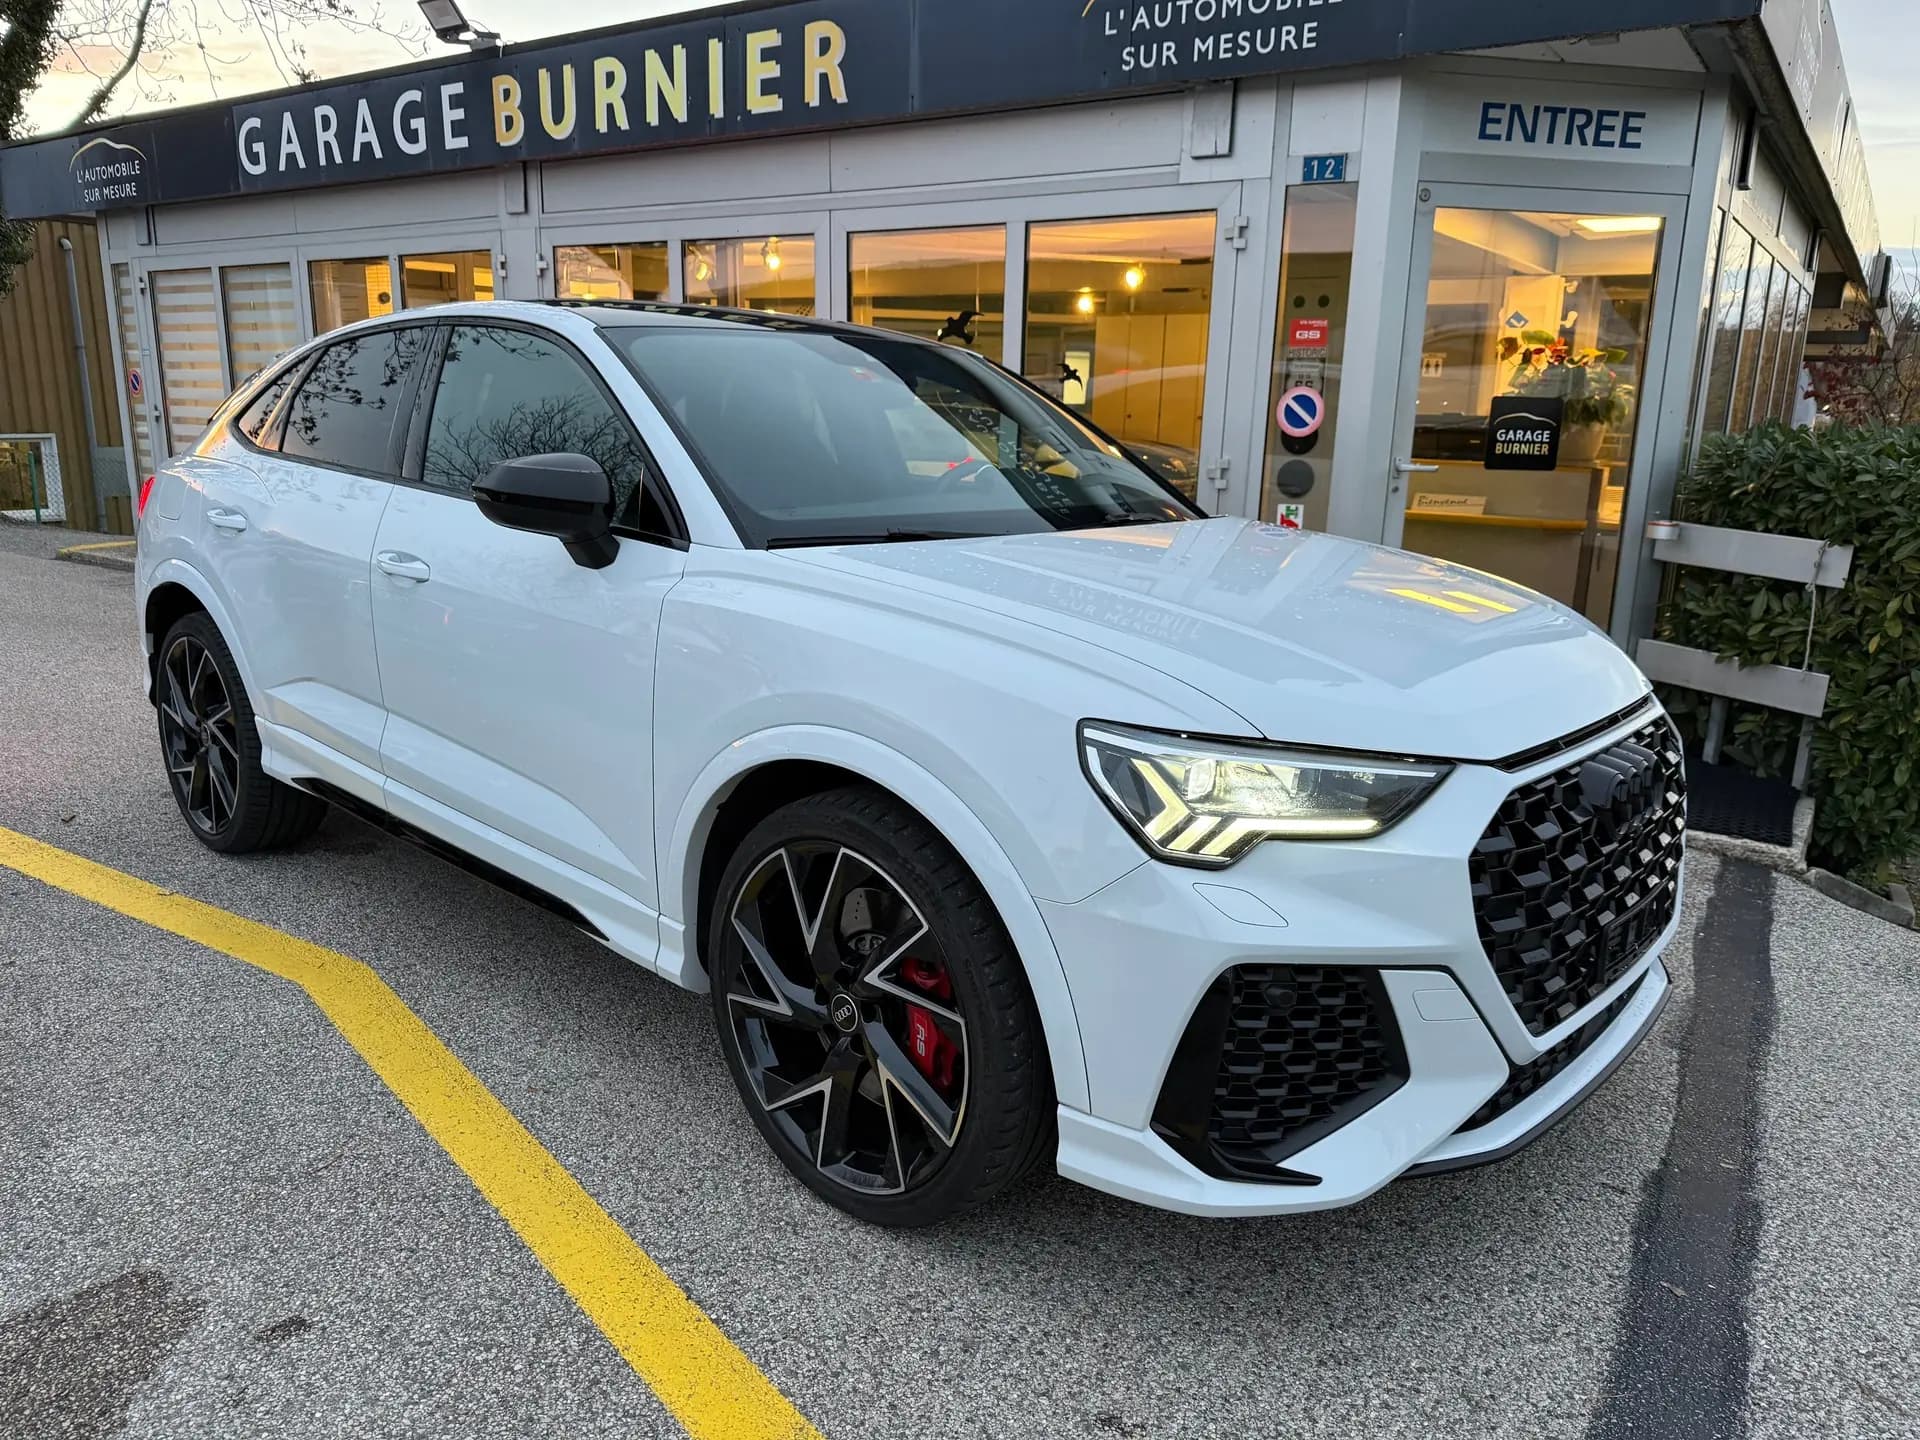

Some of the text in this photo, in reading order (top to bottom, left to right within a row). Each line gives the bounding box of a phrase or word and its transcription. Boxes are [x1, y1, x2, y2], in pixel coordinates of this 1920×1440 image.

[1104, 0, 1343, 35] L'AUTOMO
[1121, 22, 1318, 71] SUR MESURE
[238, 20, 848, 175] GARAGE BURNIER
[1478, 101, 1647, 149] ENTREE
[76, 160, 141, 183] L'AUTOMOBILE
[1310, 159, 1336, 180] 12
[84, 182, 137, 202] SUR MESURE
[1495, 442, 1549, 455] BURNIER
[1496, 429, 1551, 442] GARAGE
[916, 1023, 926, 1057] RS
